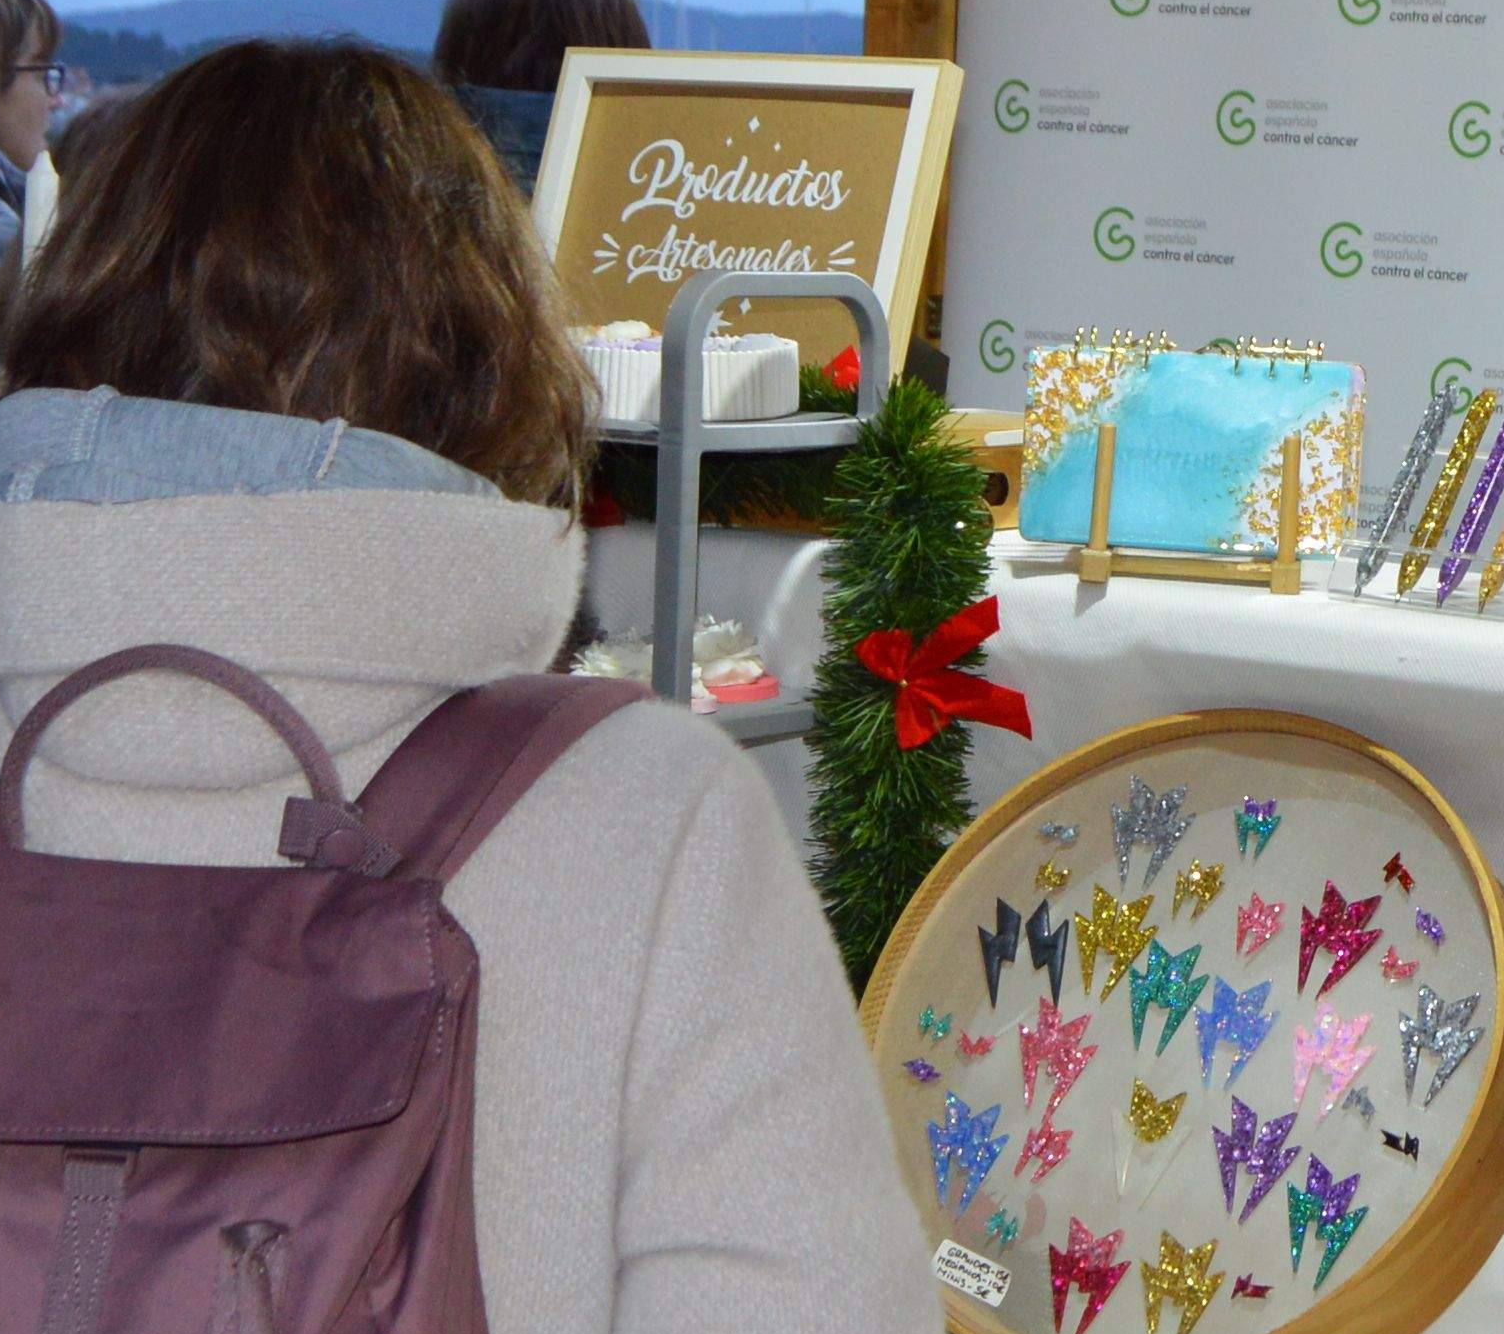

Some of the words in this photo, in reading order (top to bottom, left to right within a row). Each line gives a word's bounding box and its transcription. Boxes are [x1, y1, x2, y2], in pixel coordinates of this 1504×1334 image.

[1158, 3, 1197, 15] contra
[1199, 3, 1210, 15] el
[1212, 4, 1252, 17] cáncer
[1389, 10, 1429, 23] contra
[1432, 11, 1443, 24] el
[1445, 11, 1487, 25] cáncer
[1037, 120, 1074, 132] contra
[1075, 121, 1087, 133] el
[1089, 122, 1130, 136] cáncer
[1263, 132, 1301, 144] contra
[1303, 132, 1314, 145] el
[1316, 133, 1359, 147] cáncer
[621, 138, 851, 222] Productos
[626, 224, 818, 283] Artesanales
[1142, 249, 1181, 262] contra
[1183, 249, 1194, 263] el
[1196, 251, 1236, 265] cáncer
[1371, 264, 1411, 277] contra
[1413, 264, 1425, 278] el
[1427, 266, 1470, 282] cáncer
